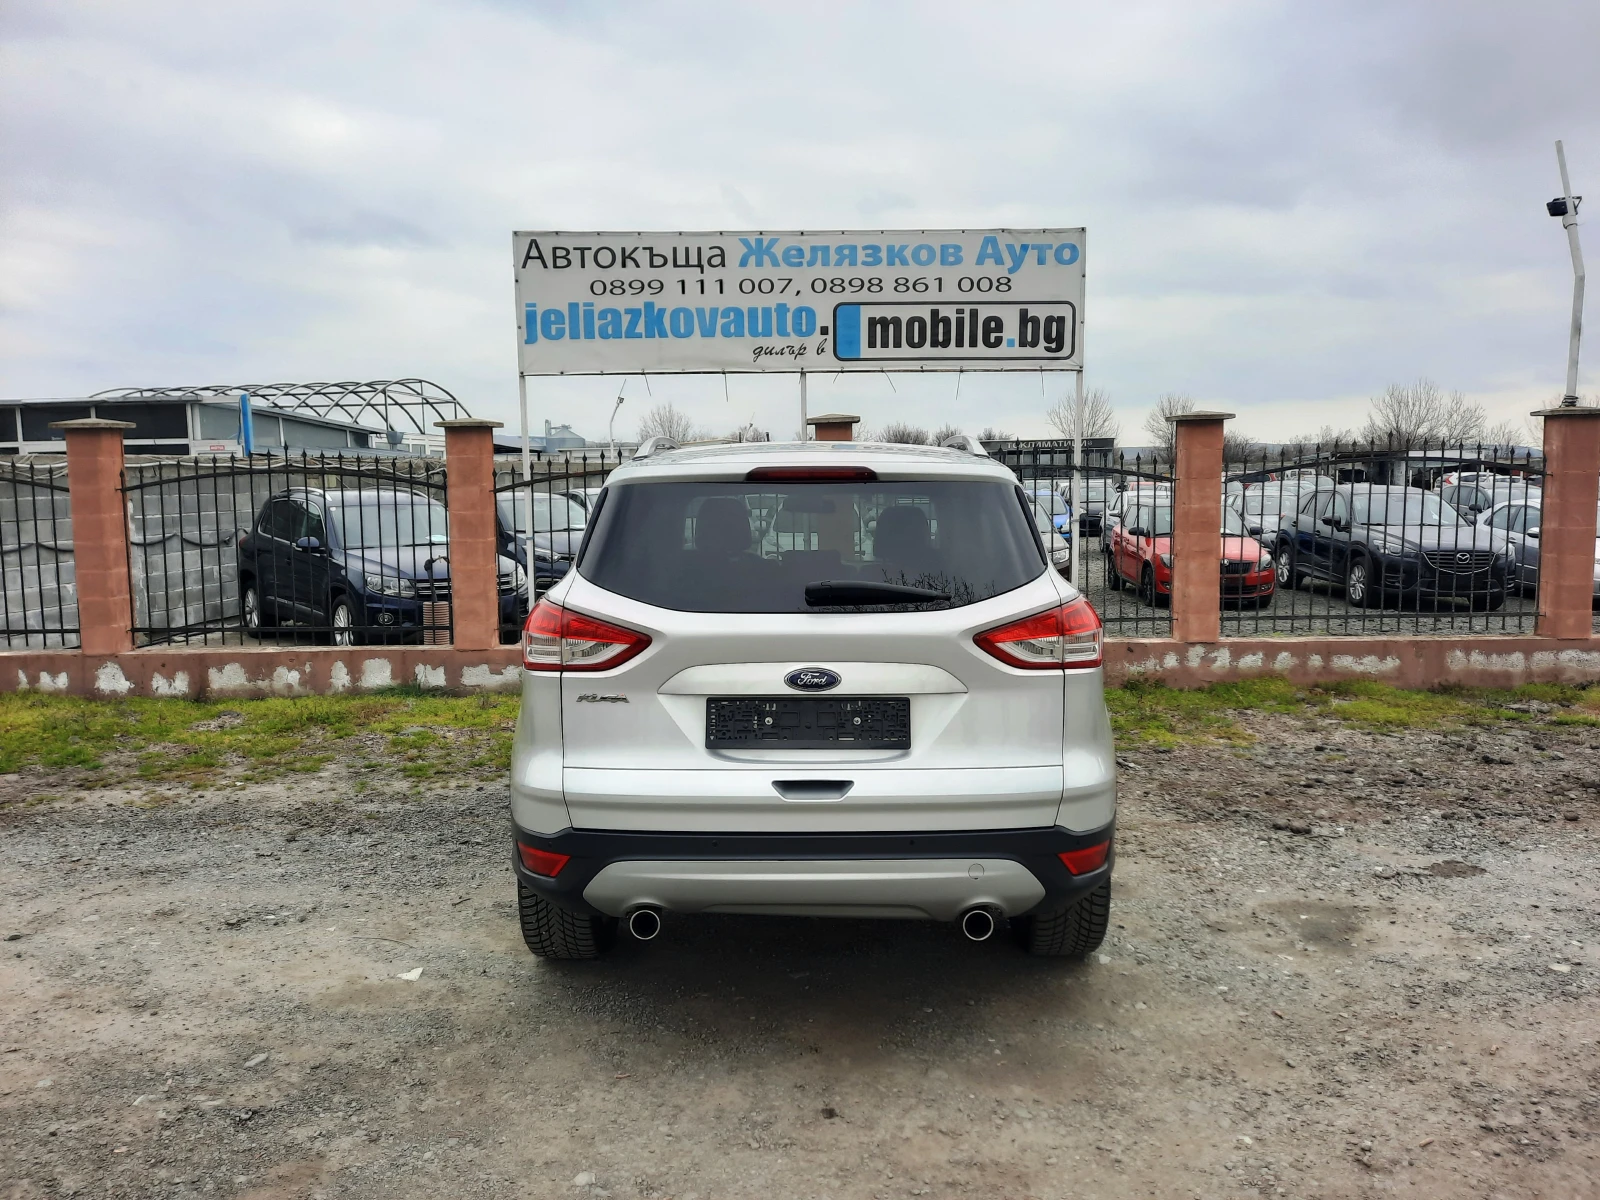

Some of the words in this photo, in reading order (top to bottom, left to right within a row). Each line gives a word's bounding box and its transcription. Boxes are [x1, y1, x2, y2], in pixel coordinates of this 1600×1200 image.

[521, 238, 726, 274] Автокъща
[738, 237, 964, 268] Желязков
[975, 235, 1080, 275] Ауто
[589, 279, 665, 296] 0899
[676, 278, 725, 295] 111
[738, 277, 802, 297] 007,
[810, 276, 884, 294] 0898
[893, 276, 944, 293] 861
[957, 276, 1013, 293] 008
[867, 308, 1067, 353] mobile.bg
[752, 342, 808, 363] дилър
[797, 672, 828, 686] Ford
